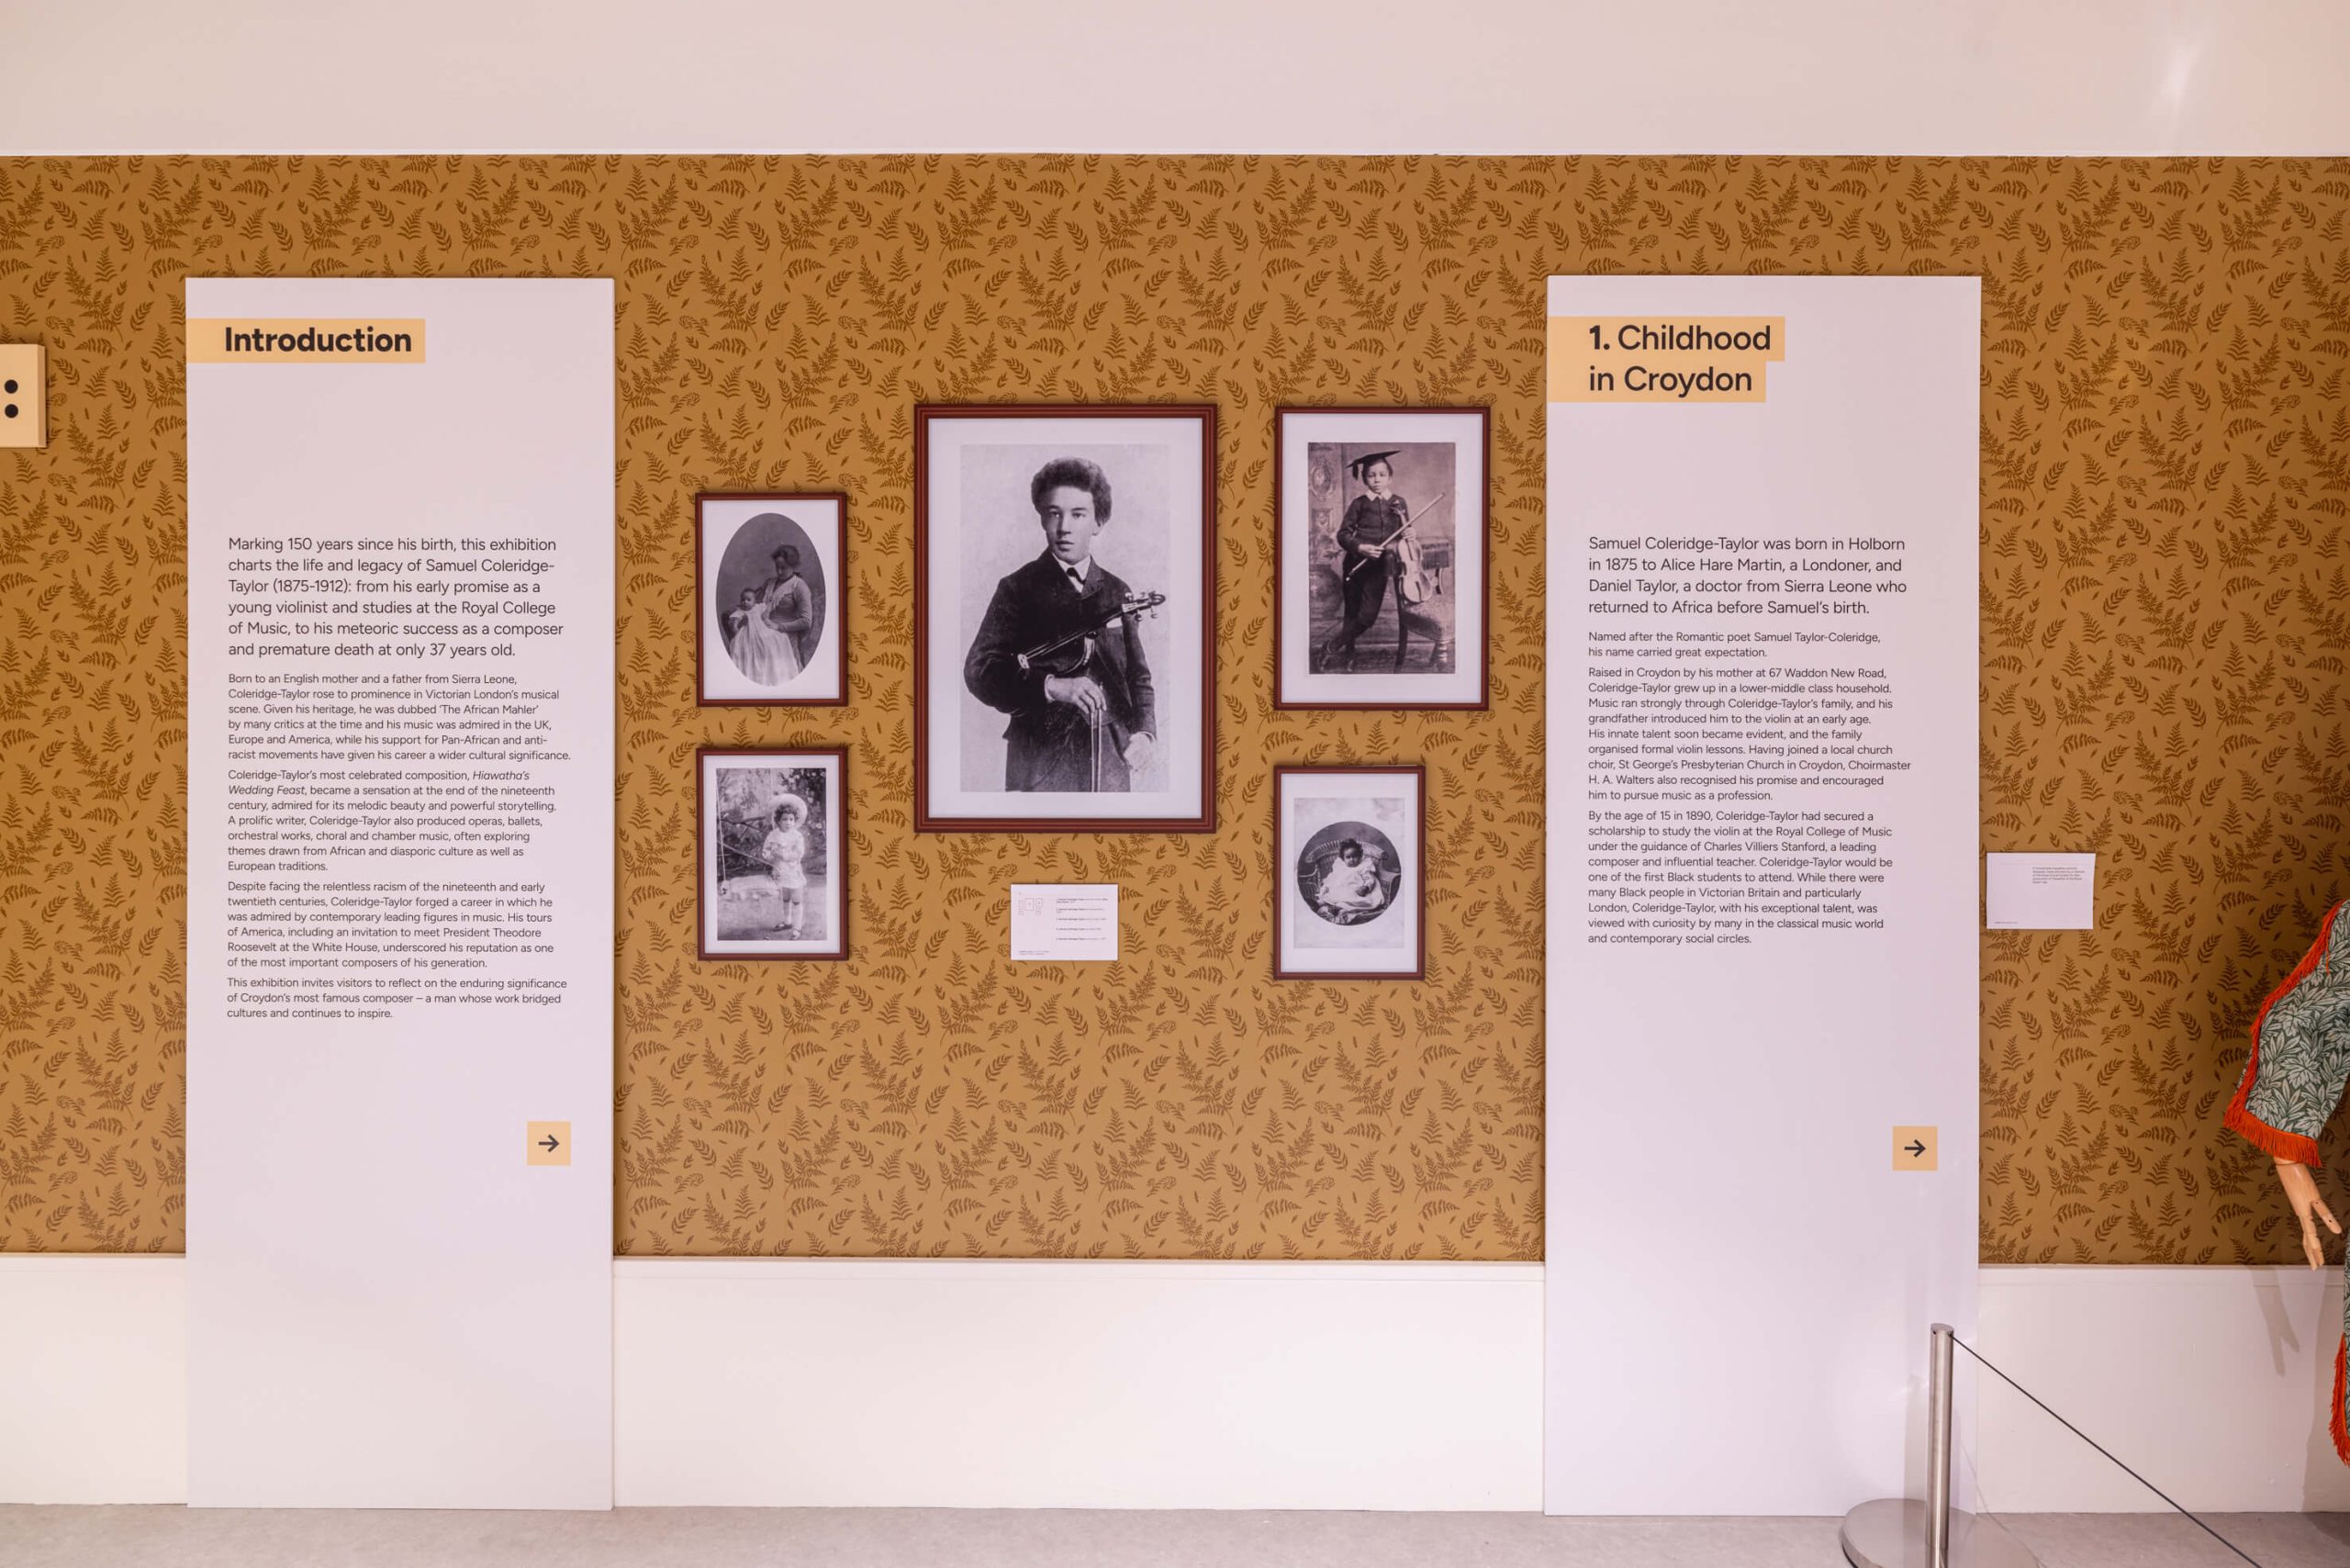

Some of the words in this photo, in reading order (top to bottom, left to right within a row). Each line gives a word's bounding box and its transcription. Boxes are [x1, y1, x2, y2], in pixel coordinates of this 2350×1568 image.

[225, 326, 412, 352] Introduction
[1589, 325, 1610, 350] 1.
[1617, 324, 1771, 351] Childhood
[1589, 365, 1614, 391] in
[1624, 365, 1752, 398] Croydon
[229, 537, 284, 554] Marking
[287, 537, 312, 550] 150
[316, 541, 353, 554] years
[357, 537, 394, 551] since
[397, 537, 417, 551] his
[421, 537, 456, 553] birth,
[460, 538, 486, 551] this
[489, 538, 556, 551] exhibition
[1589, 536, 1640, 550] Samuel
[1645, 536, 1760, 554] Coleridge-Taylor
[1762, 540, 1791, 550] was
[1795, 537, 1828, 550] born
[1832, 537, 1844, 550] in
[1849, 537, 1905, 551] Holborn
[1589, 557, 1601, 571] in
[1606, 557, 1638, 571] 1875
[1641, 558, 1657, 571] to
[1661, 558, 1695, 571] Alice
[1700, 558, 1733, 571] Hare
[1738, 558, 1785, 573] Martin,
[1789, 561, 1797, 571] a
[1803, 558, 1872, 573] Londoner,
[1875, 558, 1902, 572] and
[228, 579, 269, 596] Taylor
[273, 577, 352, 594] (1875-1912):
[355, 579, 388, 593] from
[393, 579, 412, 593] his
[416, 580, 450, 596] early
[453, 580, 509, 596] promise
[513, 583, 529, 593] as
[532, 583, 541, 593] a
[1589, 600, 1649, 613] returned
[1652, 601, 1668, 613] to
[1672, 600, 1713, 614] Africa
[1718, 600, 1763, 614] before
[1767, 600, 1830, 614] Samuel’s
[1833, 600, 1869, 614] birth.
[229, 643, 254, 655] and
[259, 644, 330, 658] premature
[334, 643, 375, 656] death
[378, 644, 392, 656] at
[396, 643, 426, 659] only
[430, 643, 446, 656] 37
[450, 646, 487, 659] years
[490, 643, 515, 656] old.
[1588, 646, 1603, 656] his
[1637, 647, 1673, 656] carried
[1674, 647, 1702, 659] great
[1705, 647, 1767, 659] expectation.
[229, 673, 252, 683] Born
[254, 674, 266, 683] to
[284, 674, 319, 686] English
[322, 674, 359, 684] mother
[361, 674, 380, 684] and
[383, 676, 389, 684] a
[392, 674, 422, 684] father
[425, 674, 449, 684] from
[452, 674, 481, 684] Sierra
[484, 674, 517, 685] Leone,
[1588, 682, 1672, 695] Coleridge-Taylor
[1673, 685, 1700, 695] grew
[1702, 685, 1716, 695] up
[1718, 683, 1728, 693] in
[1730, 685, 1737, 693] a
[1740, 683, 1806, 693] lower-middle
[1807, 683, 1833, 693] class
[1836, 683, 1892, 693] household.
[1589, 729, 1606, 738] His
[1607, 729, 1639, 739] innate
[1641, 729, 1671, 739] talent
[1674, 731, 1699, 739] soon
[1702, 729, 1743, 739] became
[1746, 729, 1786, 740] evident,
[1789, 729, 1808, 739] and
[1811, 730, 1829, 739] the
[1831, 729, 1863, 742] family
[1589, 775, 1600, 784] H.
[1602, 775, 1613, 784] A.
[1616, 775, 1654, 785] Walters
[1657, 775, 1678, 785] also
[1680, 775, 1737, 787] recognised
[1740, 775, 1754, 785] his
[1756, 775, 1798, 787] promise
[1800, 776, 1819, 785] and
[1822, 776, 1884, 788] encouraged
[228, 801, 269, 812] century,
[271, 801, 313, 811] admired
[316, 801, 330, 811] for
[332, 801, 344, 811] its
[347, 801, 387, 811] melodic
[390, 801, 426, 812] beauty
[428, 801, 447, 811] and
[450, 801, 495, 812] powerful
[498, 801, 556, 813] storytelling.
[1588, 825, 1646, 837] scholarship
[1649, 826, 1660, 835] to
[1662, 826, 1691, 838] study
[1694, 826, 1711, 836] the
[1714, 826, 1740, 836] violin
[1742, 827, 1753, 836] at
[1755, 826, 1774, 836] the
[1776, 826, 1804, 838] Royal
[1806, 826, 1846, 839] College
[1848, 826, 1860, 836] of
[1863, 826, 1892, 836] Music
[228, 860, 275, 873] European
[278, 861, 328, 871] traditions.
[1610, 872, 1622, 881] of
[1624, 872, 1641, 882] the
[1644, 872, 1664, 882] first
[1667, 872, 1695, 882] Black
[1697, 872, 1742, 882] students
[1744, 872, 1756, 882] to
[1758, 872, 1795, 882] attend.
[1796, 872, 1827, 882] While
[1829, 872, 1856, 882] there
[228, 913, 248, 922] was
[250, 912, 291, 922] admired
[295, 913, 308, 924] by
[309, 913, 382, 924] contemporary
[384, 912, 420, 924] leading
[423, 912, 458, 924] figures
[461, 912, 470, 922] in
[473, 913, 505, 923] music.
[508, 913, 524, 923] His
[526, 913, 553, 923] tours
[1588, 934, 1607, 943] and
[1610, 934, 1683, 946] contemporary
[1685, 934, 1714, 944] social
[1717, 934, 1751, 944] circles.
[227, 957, 238, 967] of
[241, 958, 258, 967] the
[261, 958, 286, 967] most
[289, 958, 339, 969] important
[341, 959, 398, 969] composers
[400, 958, 411, 968] of
[414, 958, 429, 968] his
[431, 958, 487, 969] generation.
[227, 1008, 268, 1018] cultures
[270, 1008, 289, 1018] and
[292, 1008, 341, 1018] continues
[344, 1009, 355, 1018] to
[358, 1008, 393, 1020] inspire.
